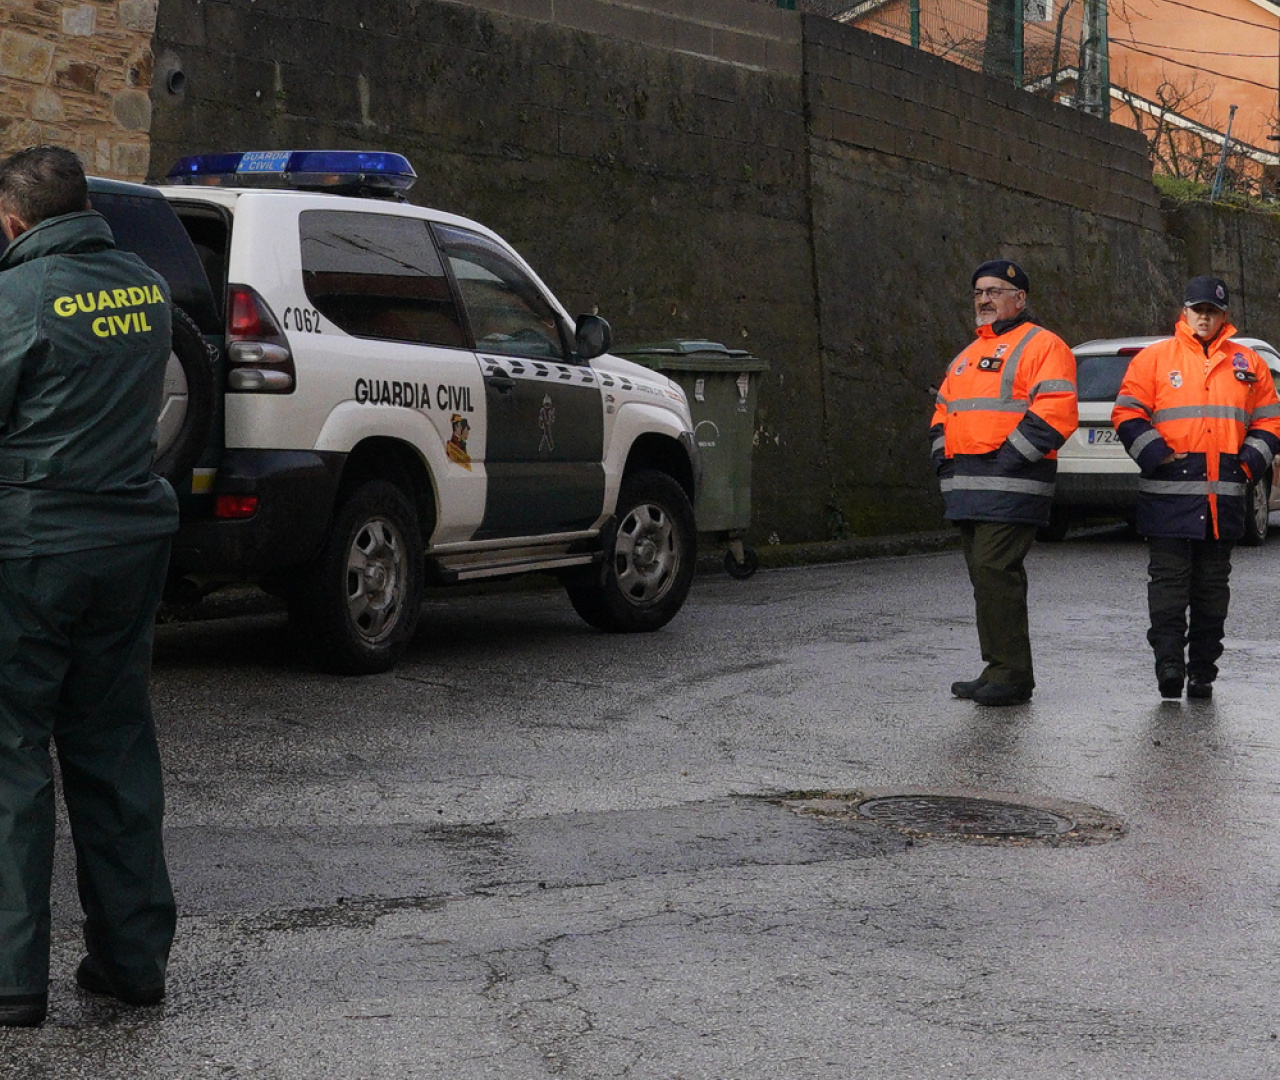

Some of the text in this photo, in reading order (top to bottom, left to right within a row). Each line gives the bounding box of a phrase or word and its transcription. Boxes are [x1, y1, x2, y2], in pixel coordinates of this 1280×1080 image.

[242, 152, 290, 160] GUARDIA
[249, 161, 274, 170] CIVIL
[53, 284, 165, 318] GUARDIA
[91, 311, 152, 338] CIVIL
[294, 307, 322, 334] 062
[355, 378, 475, 413] GUARDIA CIVIL
